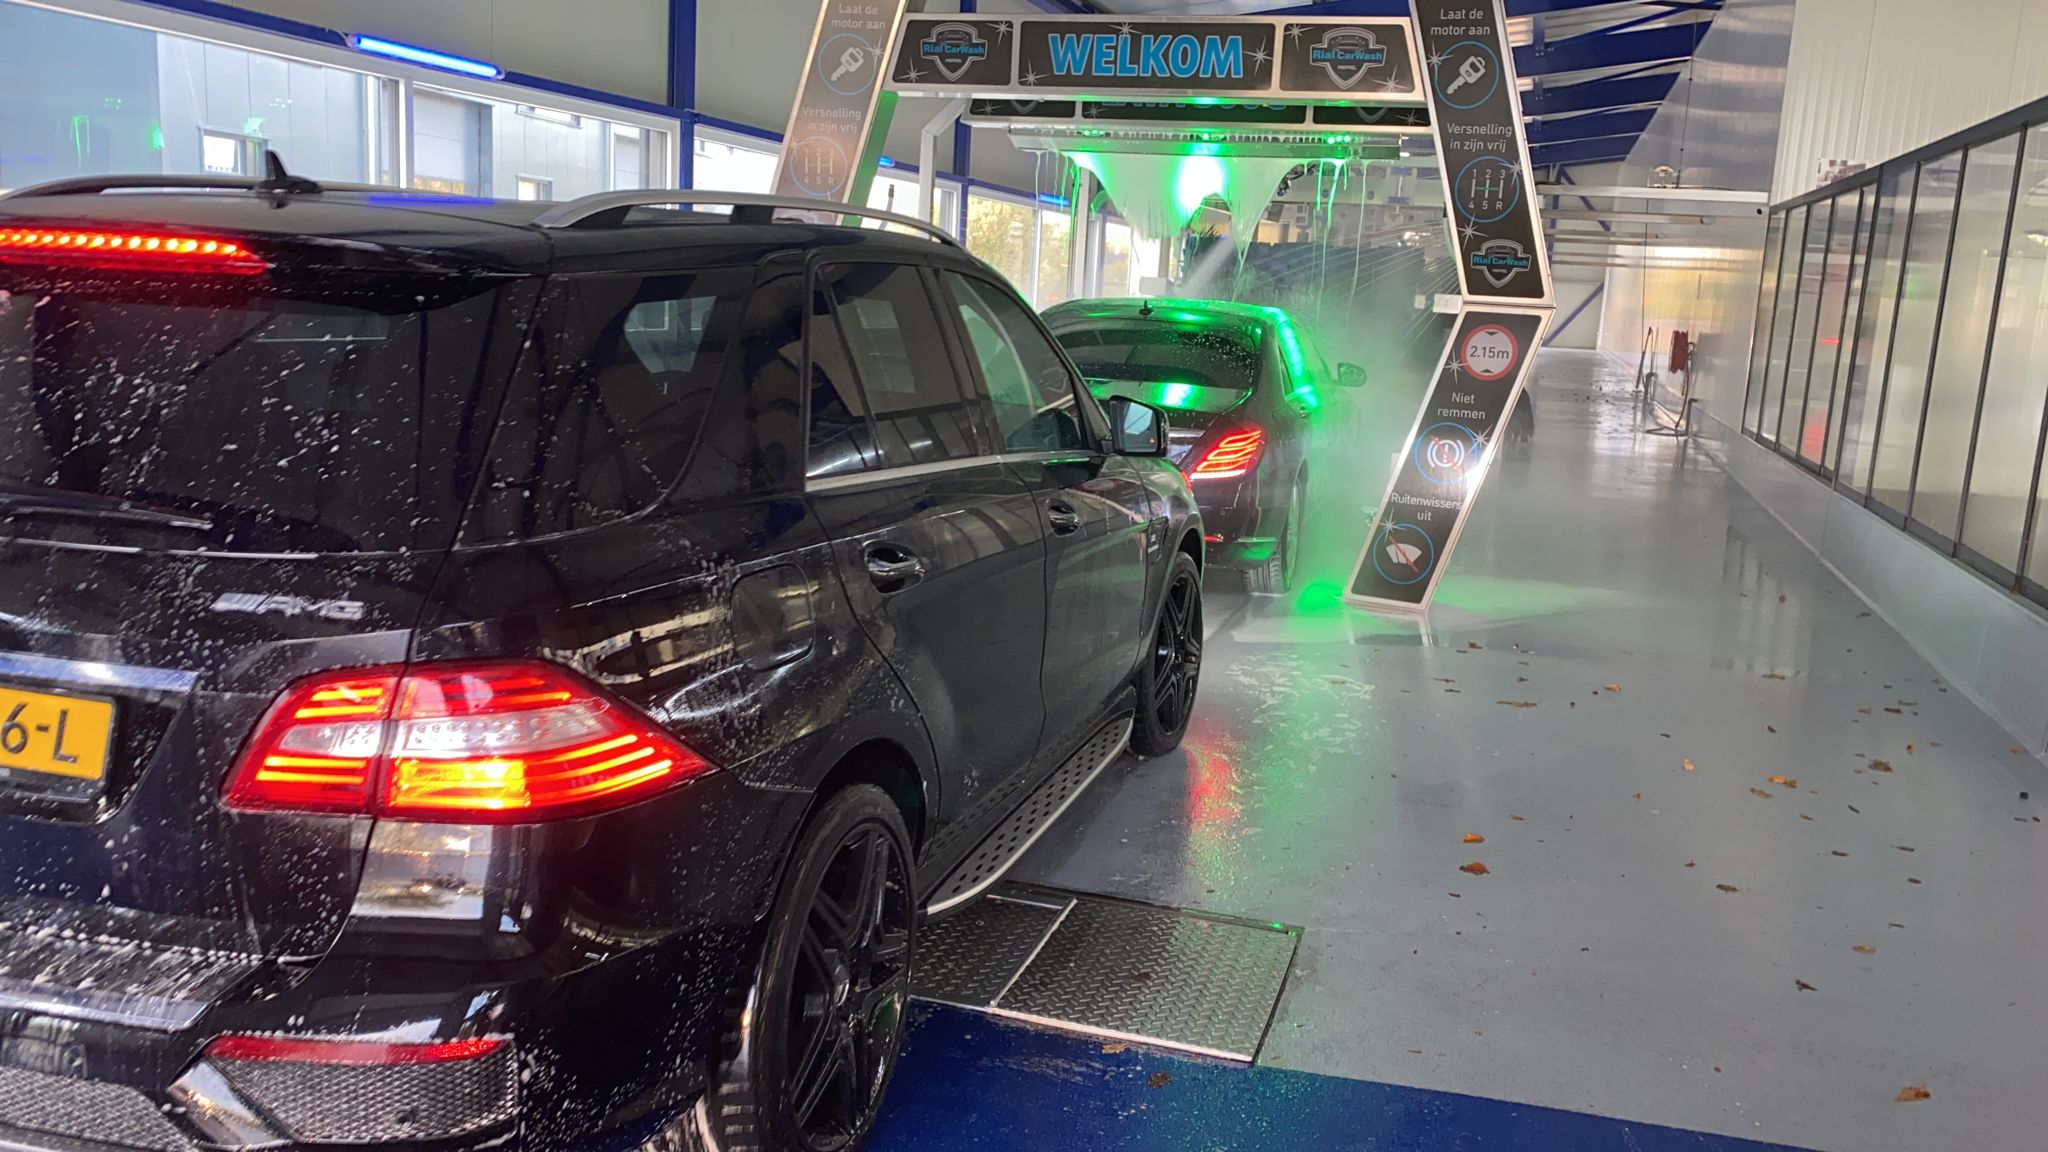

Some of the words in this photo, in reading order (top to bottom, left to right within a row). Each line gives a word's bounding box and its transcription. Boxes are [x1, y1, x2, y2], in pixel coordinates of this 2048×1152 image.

[838, 3, 862, 14] Laat
[864, 4, 879, 15] de
[1440, 8, 1466, 20] Laat
[1468, 8, 1484, 20] de
[831, 18, 863, 29] motor
[865, 20, 886, 30] aan
[1430, 25, 1466, 36] motor
[1468, 26, 1491, 36] aan
[923, 43, 943, 54] Rial
[944, 45, 985, 54] CarWash
[1312, 48, 1335, 60] Rial
[1337, 50, 1383, 61] CarWash
[1048, 33, 1243, 78] WELKOM
[802, 105, 862, 121] Versnelling
[819, 120, 838, 134] zijn
[840, 122, 858, 136] vrij
[1447, 122, 1513, 138] Versnelling
[1449, 138, 1461, 150] in
[1463, 138, 1484, 153] zijn
[1487, 139, 1507, 153] vrij
[1472, 169, 1477, 178] 1
[1485, 170, 1492, 178] 2
[1499, 170, 1506, 179] 3
[1468, 201, 1475, 209] 4
[1482, 201, 1488, 210] 5
[1496, 202, 1503, 211] R
[1473, 255, 1491, 264] Rial
[1492, 256, 1529, 267] CarWash
[1470, 345, 1509, 360] 2.15m
[1451, 392, 1475, 404] Niet
[1437, 408, 1486, 420] remmen
[1391, 492, 1463, 510] Ruitenwissers
[1417, 510, 1432, 521] uit
[255, 594, 365, 622] AMG
[1, 701, 80, 764] 6-L
